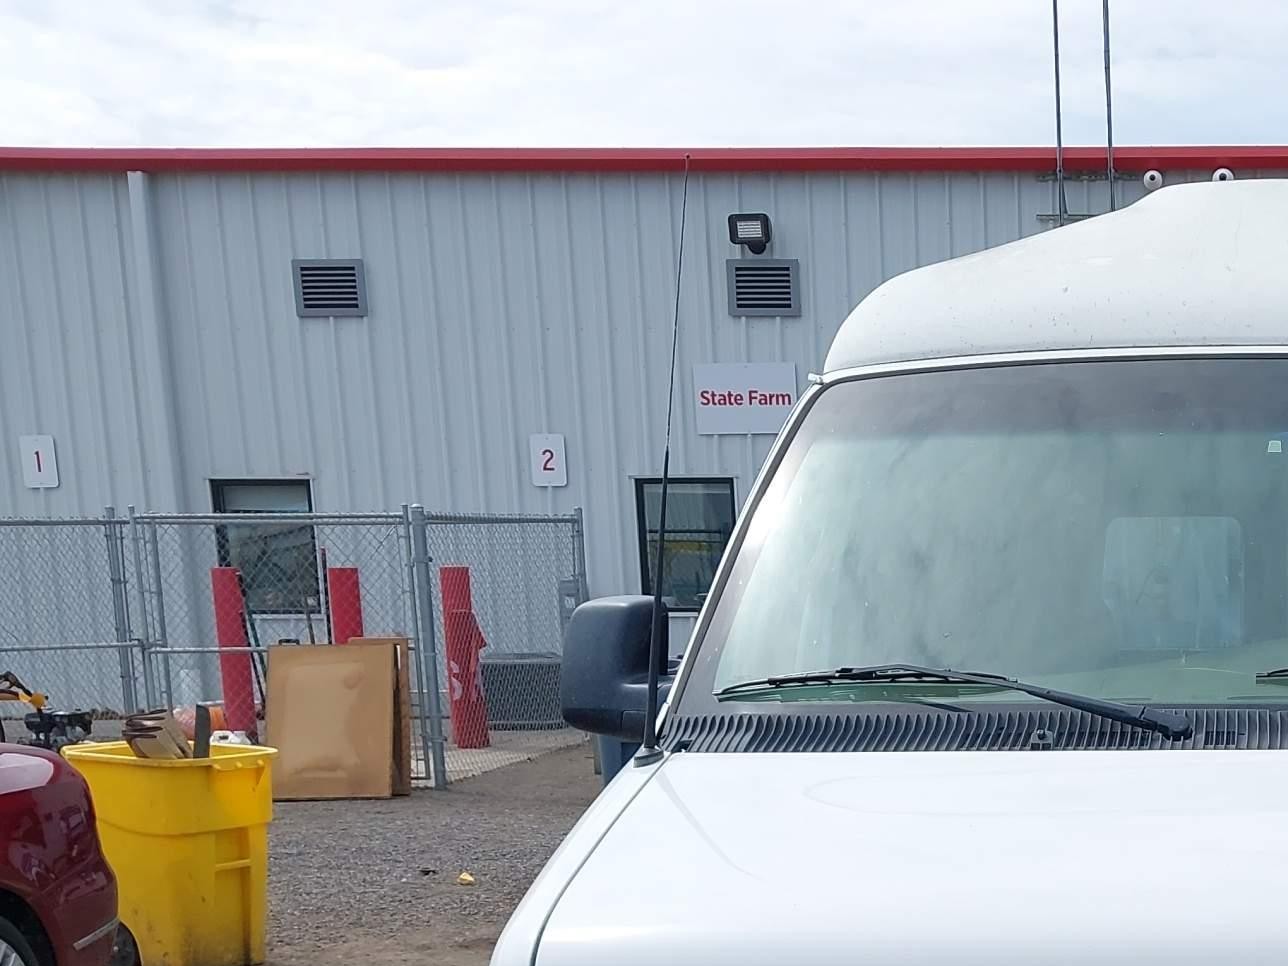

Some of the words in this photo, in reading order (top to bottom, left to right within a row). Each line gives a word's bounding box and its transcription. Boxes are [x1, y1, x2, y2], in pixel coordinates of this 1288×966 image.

[700, 390, 744, 406] State
[748, 390, 792, 406] Farm
[33, 450, 42, 473] 1
[542, 449, 555, 471] 2
